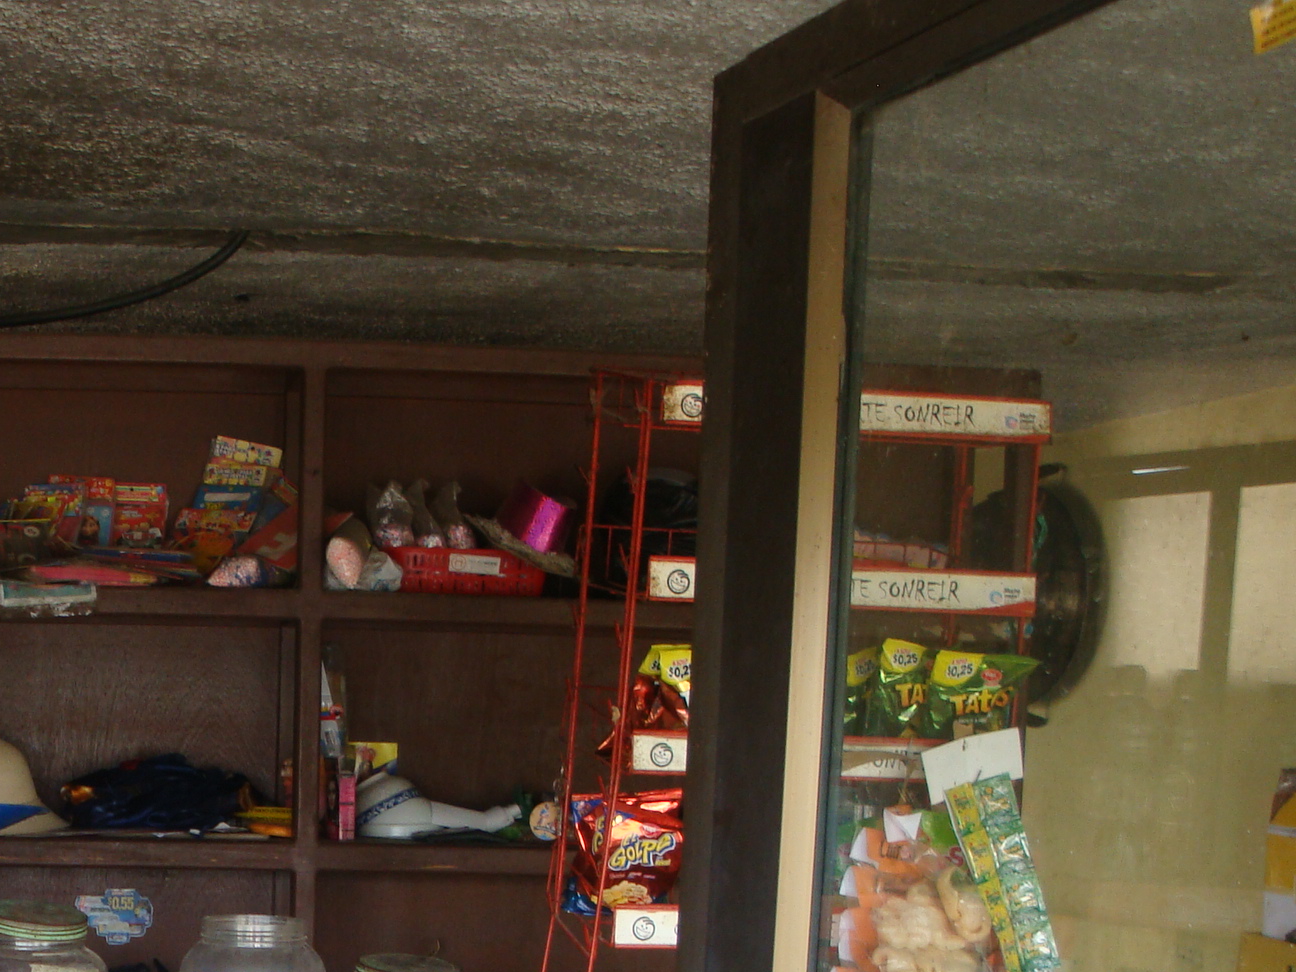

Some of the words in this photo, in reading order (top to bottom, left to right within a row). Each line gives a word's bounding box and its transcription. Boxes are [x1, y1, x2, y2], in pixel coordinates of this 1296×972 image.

[860, 402, 886, 423] TE
[892, 653, 918, 665] $0,25
[669, 664, 691, 679] $0,2
[947, 663, 973, 678] $0,25
